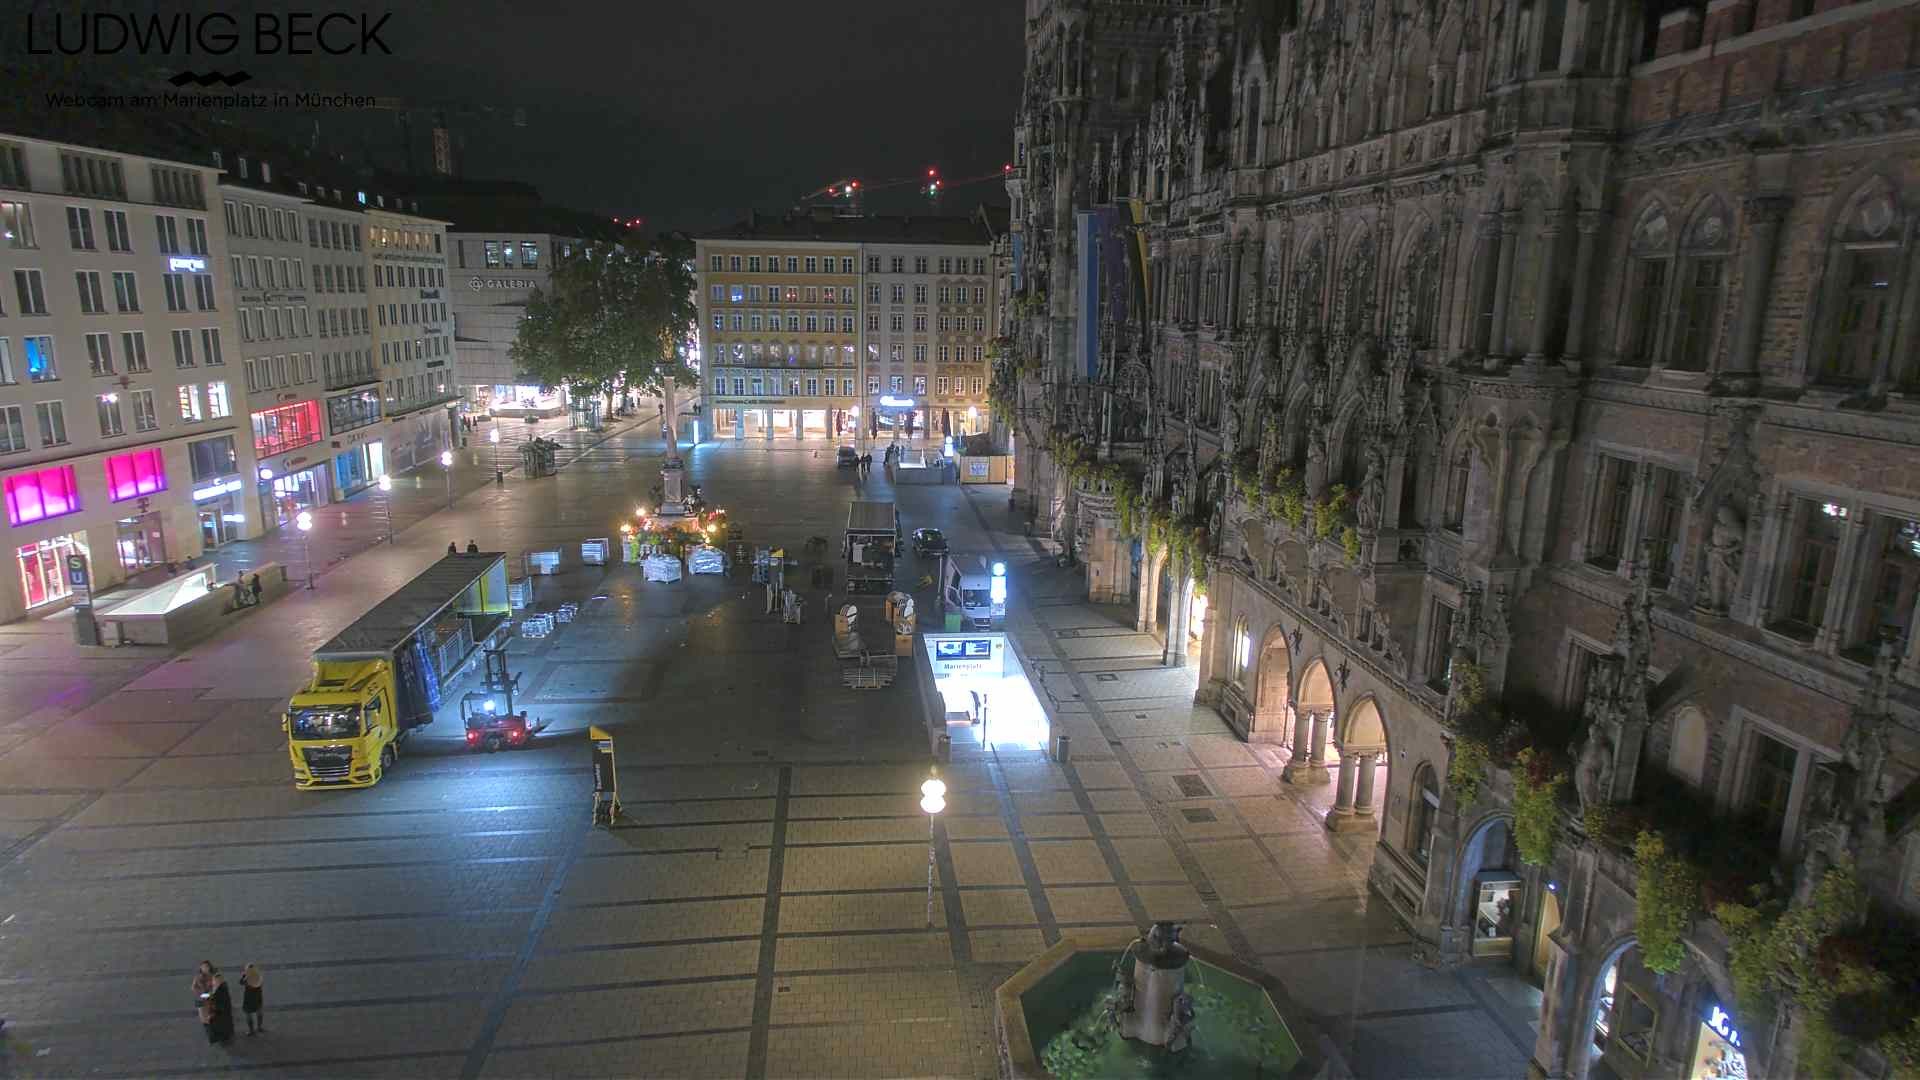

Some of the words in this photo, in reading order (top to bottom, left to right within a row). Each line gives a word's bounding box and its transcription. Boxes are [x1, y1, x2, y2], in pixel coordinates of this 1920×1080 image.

[487, 279, 536, 289] GALERIA
[70, 557, 81, 569] S
[72, 571, 83, 583] U
